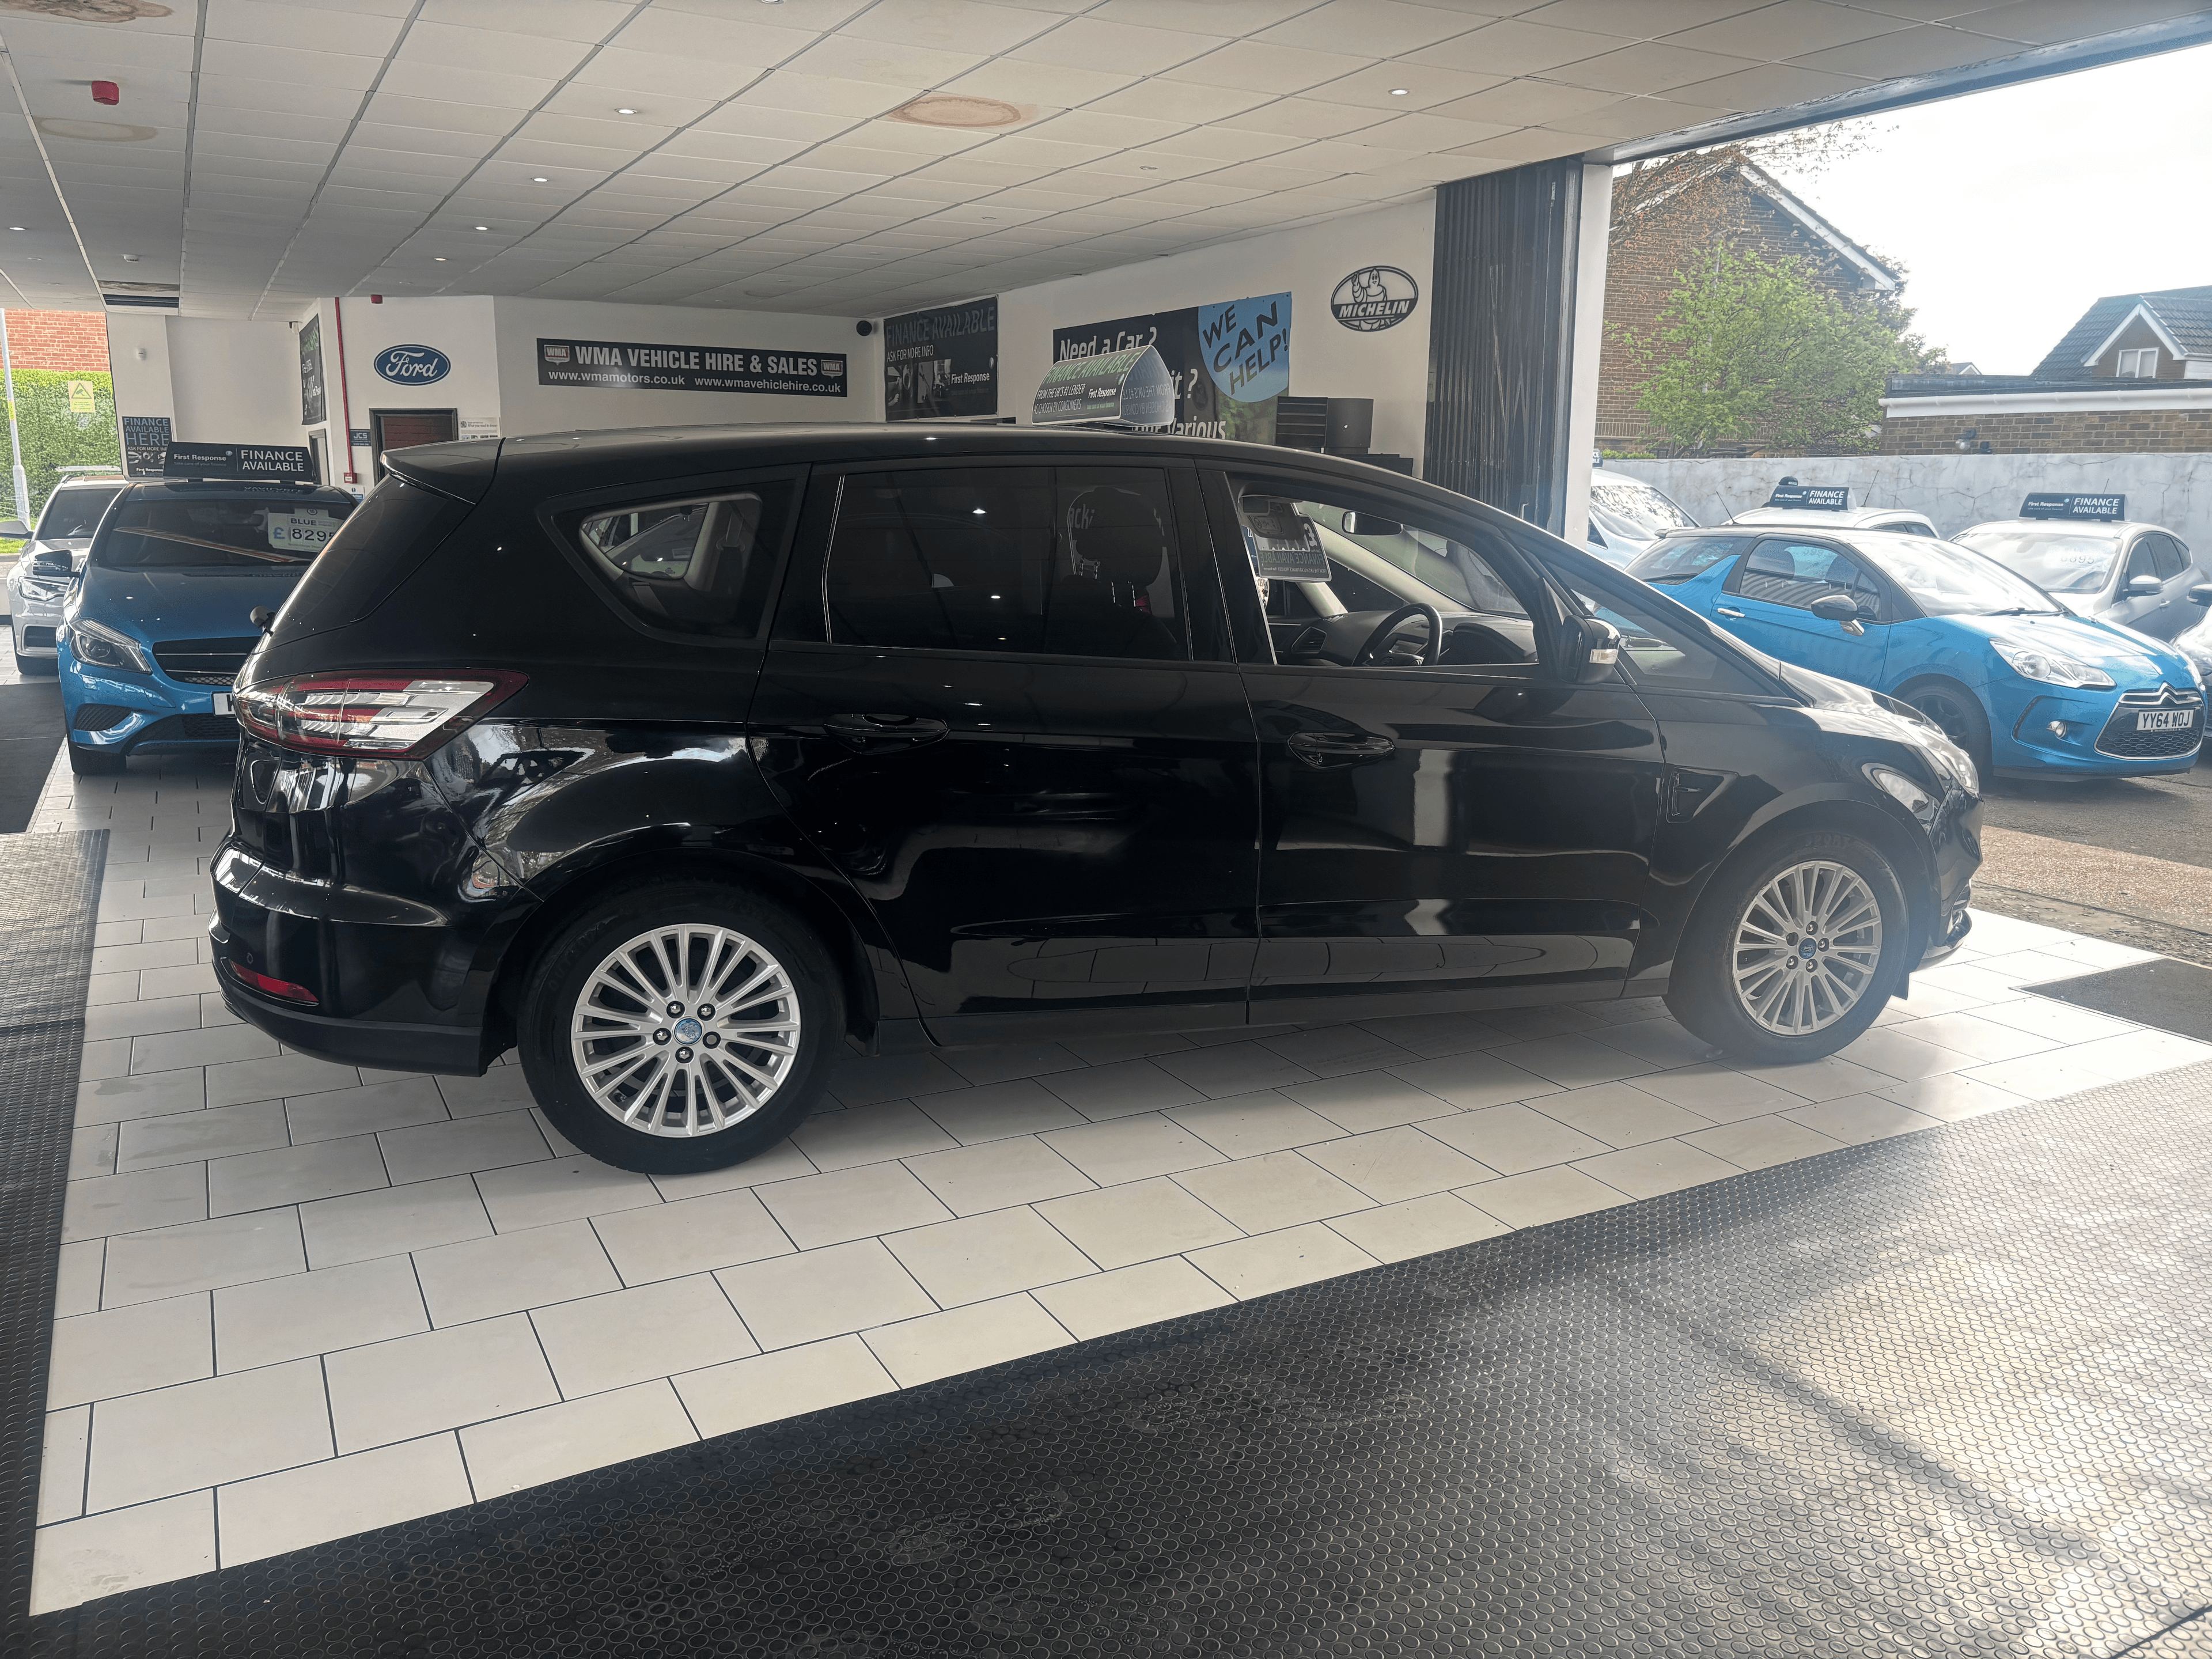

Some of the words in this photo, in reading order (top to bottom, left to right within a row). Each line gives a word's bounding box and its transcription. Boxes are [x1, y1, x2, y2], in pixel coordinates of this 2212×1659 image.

[1339, 300, 1410, 318] MICHELIN
[886, 319, 930, 347] FINANCE
[932, 306, 995, 340] AVAILABLE
[1202, 304, 1237, 349] WE
[1059, 335, 1097, 361] Need
[1101, 339, 1111, 354] a
[1116, 331, 1143, 351] Car
[1214, 301, 1278, 373] CAN
[547, 348, 567, 357] WMA
[575, 346, 623, 366] WMA
[627, 349, 700, 369] VEHICLE
[705, 352, 744, 372] HIRE
[749, 355, 762, 373] &
[767, 356, 817, 376] SALES
[887, 351, 896, 362] ASK
[897, 349, 907, 361] FOR
[908, 347, 921, 359] MORE
[922, 344, 934, 357] INFO
[385, 350, 438, 377] Ford
[823, 362, 840, 371] WMA
[1042, 361, 1086, 384] FINANCE
[1077, 352, 1142, 378] AVAILABLE
[1229, 328, 1288, 396] HELP!
[548, 371, 685, 385] www.wmamotors.co.uk
[695, 377, 841, 393] www.wmavehiclehire.co.uk
[950, 373, 963, 384] First
[964, 372, 990, 384] Response
[1187, 369, 1198, 399] ?
[1088, 388, 1098, 398] First
[1097, 388, 1116, 399] Response
[124, 418, 169, 426] FINANCE
[126, 433, 170, 446] HERE
[241, 450, 304, 461] FINANCE
[242, 461, 305, 471] AVAILABLE
[2074, 498, 2120, 506] FINANCE
[290, 518, 317, 526] BLUE
[273, 527, 285, 539] £
[2143, 713, 2169, 729] YY64
[2172, 711, 2190, 727] WOJ
